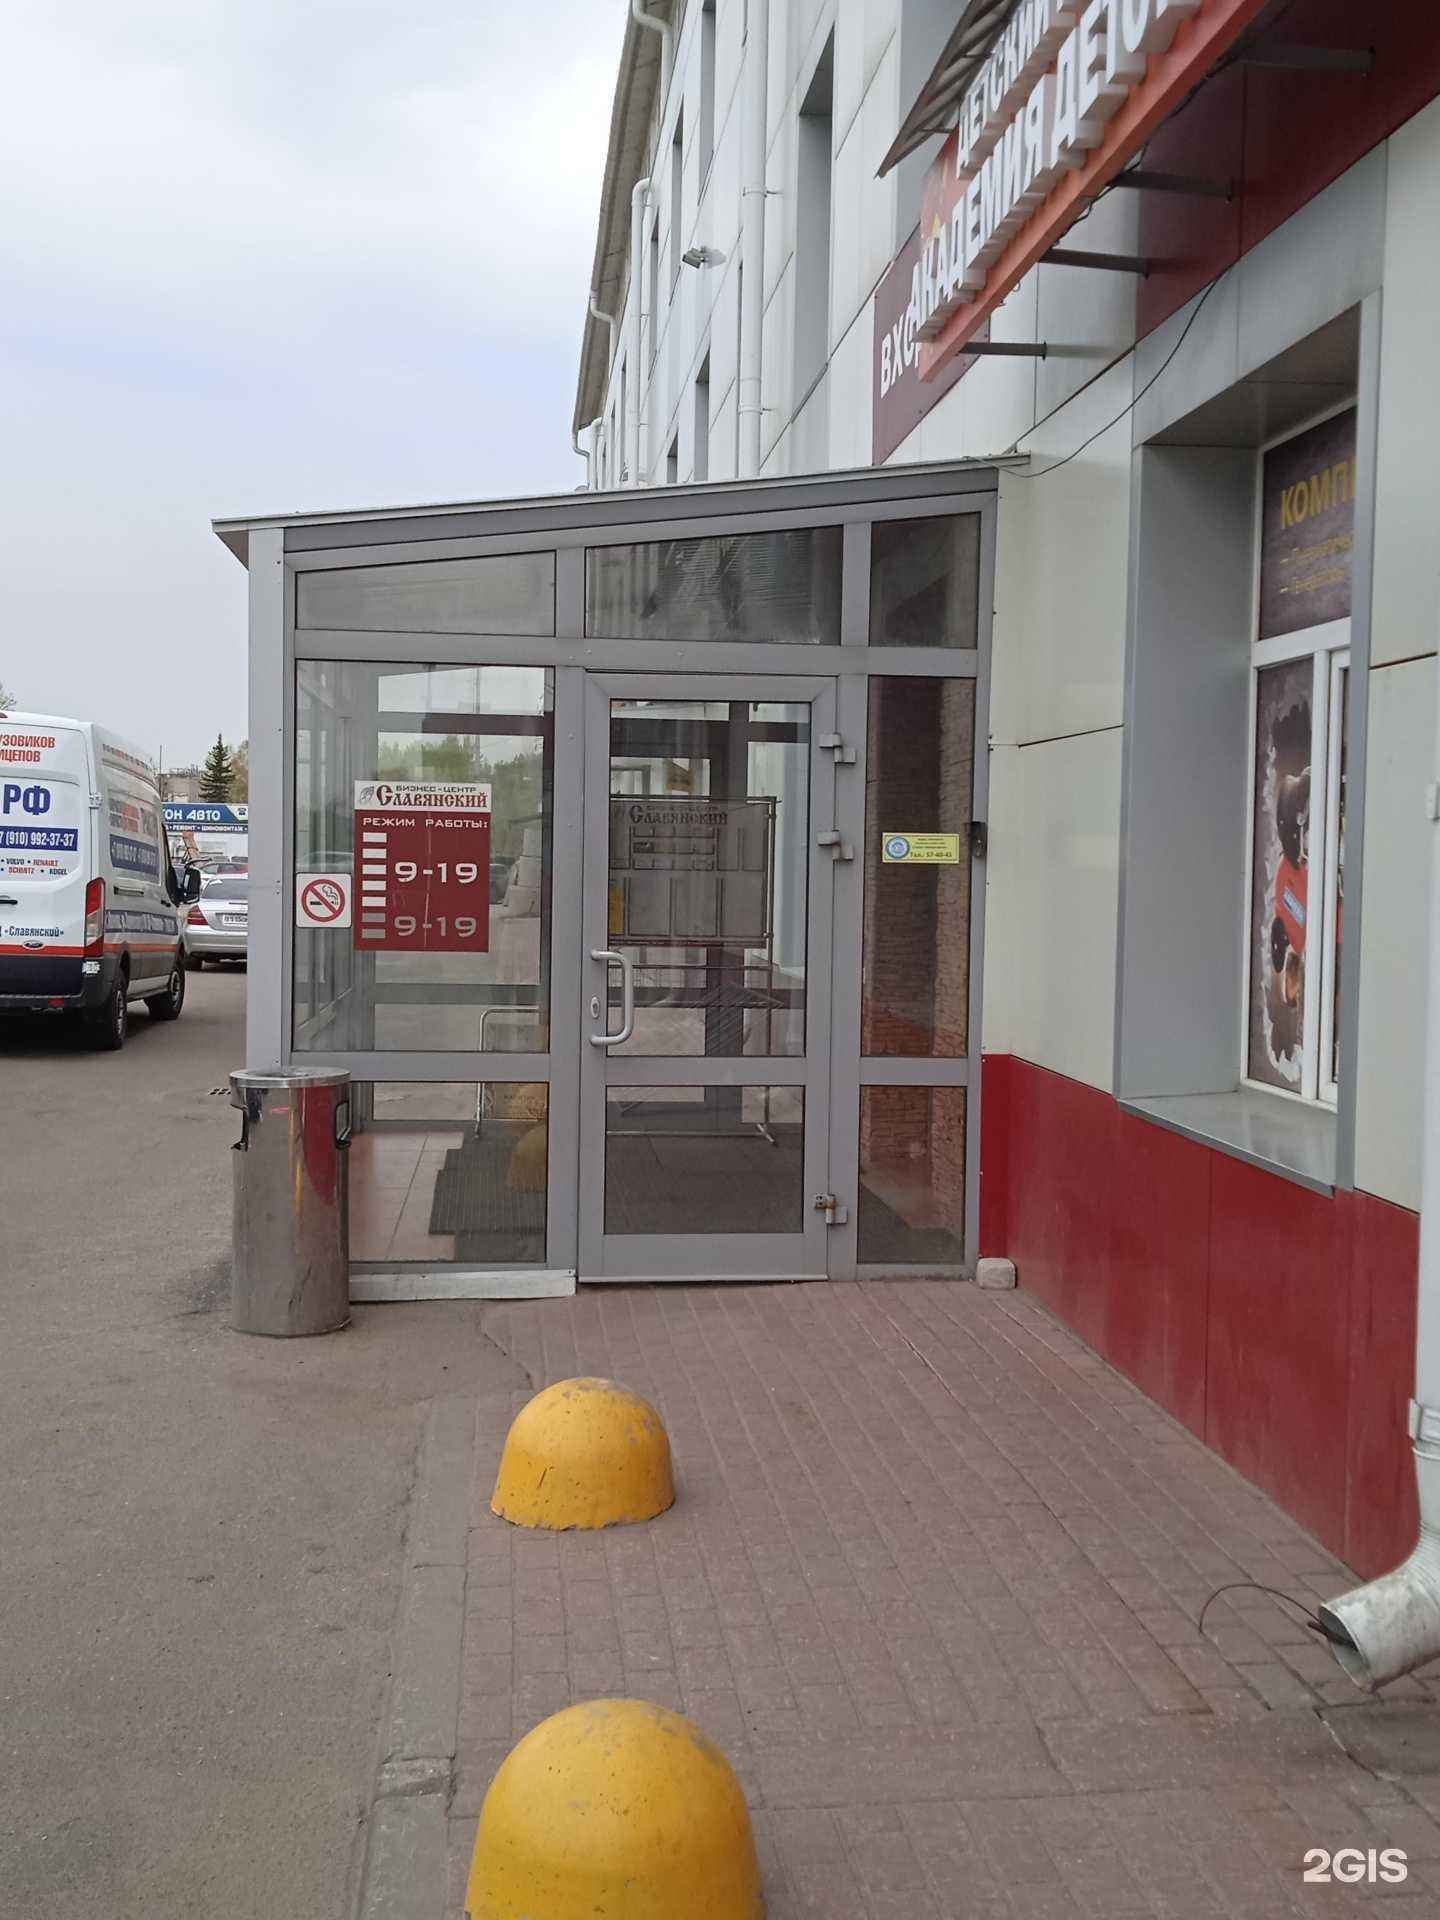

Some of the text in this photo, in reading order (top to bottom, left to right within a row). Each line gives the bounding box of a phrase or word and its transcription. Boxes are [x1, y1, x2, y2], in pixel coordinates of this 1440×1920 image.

[910, 74, 1044, 336] АКАДЕМИЯ
[1280, 456, 1357, 530] КОМП
[0, 734, 56, 749] ЗОВИКОВ
[3, 784, 51, 815] РФ
[186, 809, 221, 821] АВТО
[363, 817, 488, 829] РЕЖИМ РАБОТЫ:
[6, 831, 28, 847] (910)
[31, 832, 75, 848] 992-37-37
[394, 861, 478, 884] 9-19
[394, 916, 477, 938] 9-19
